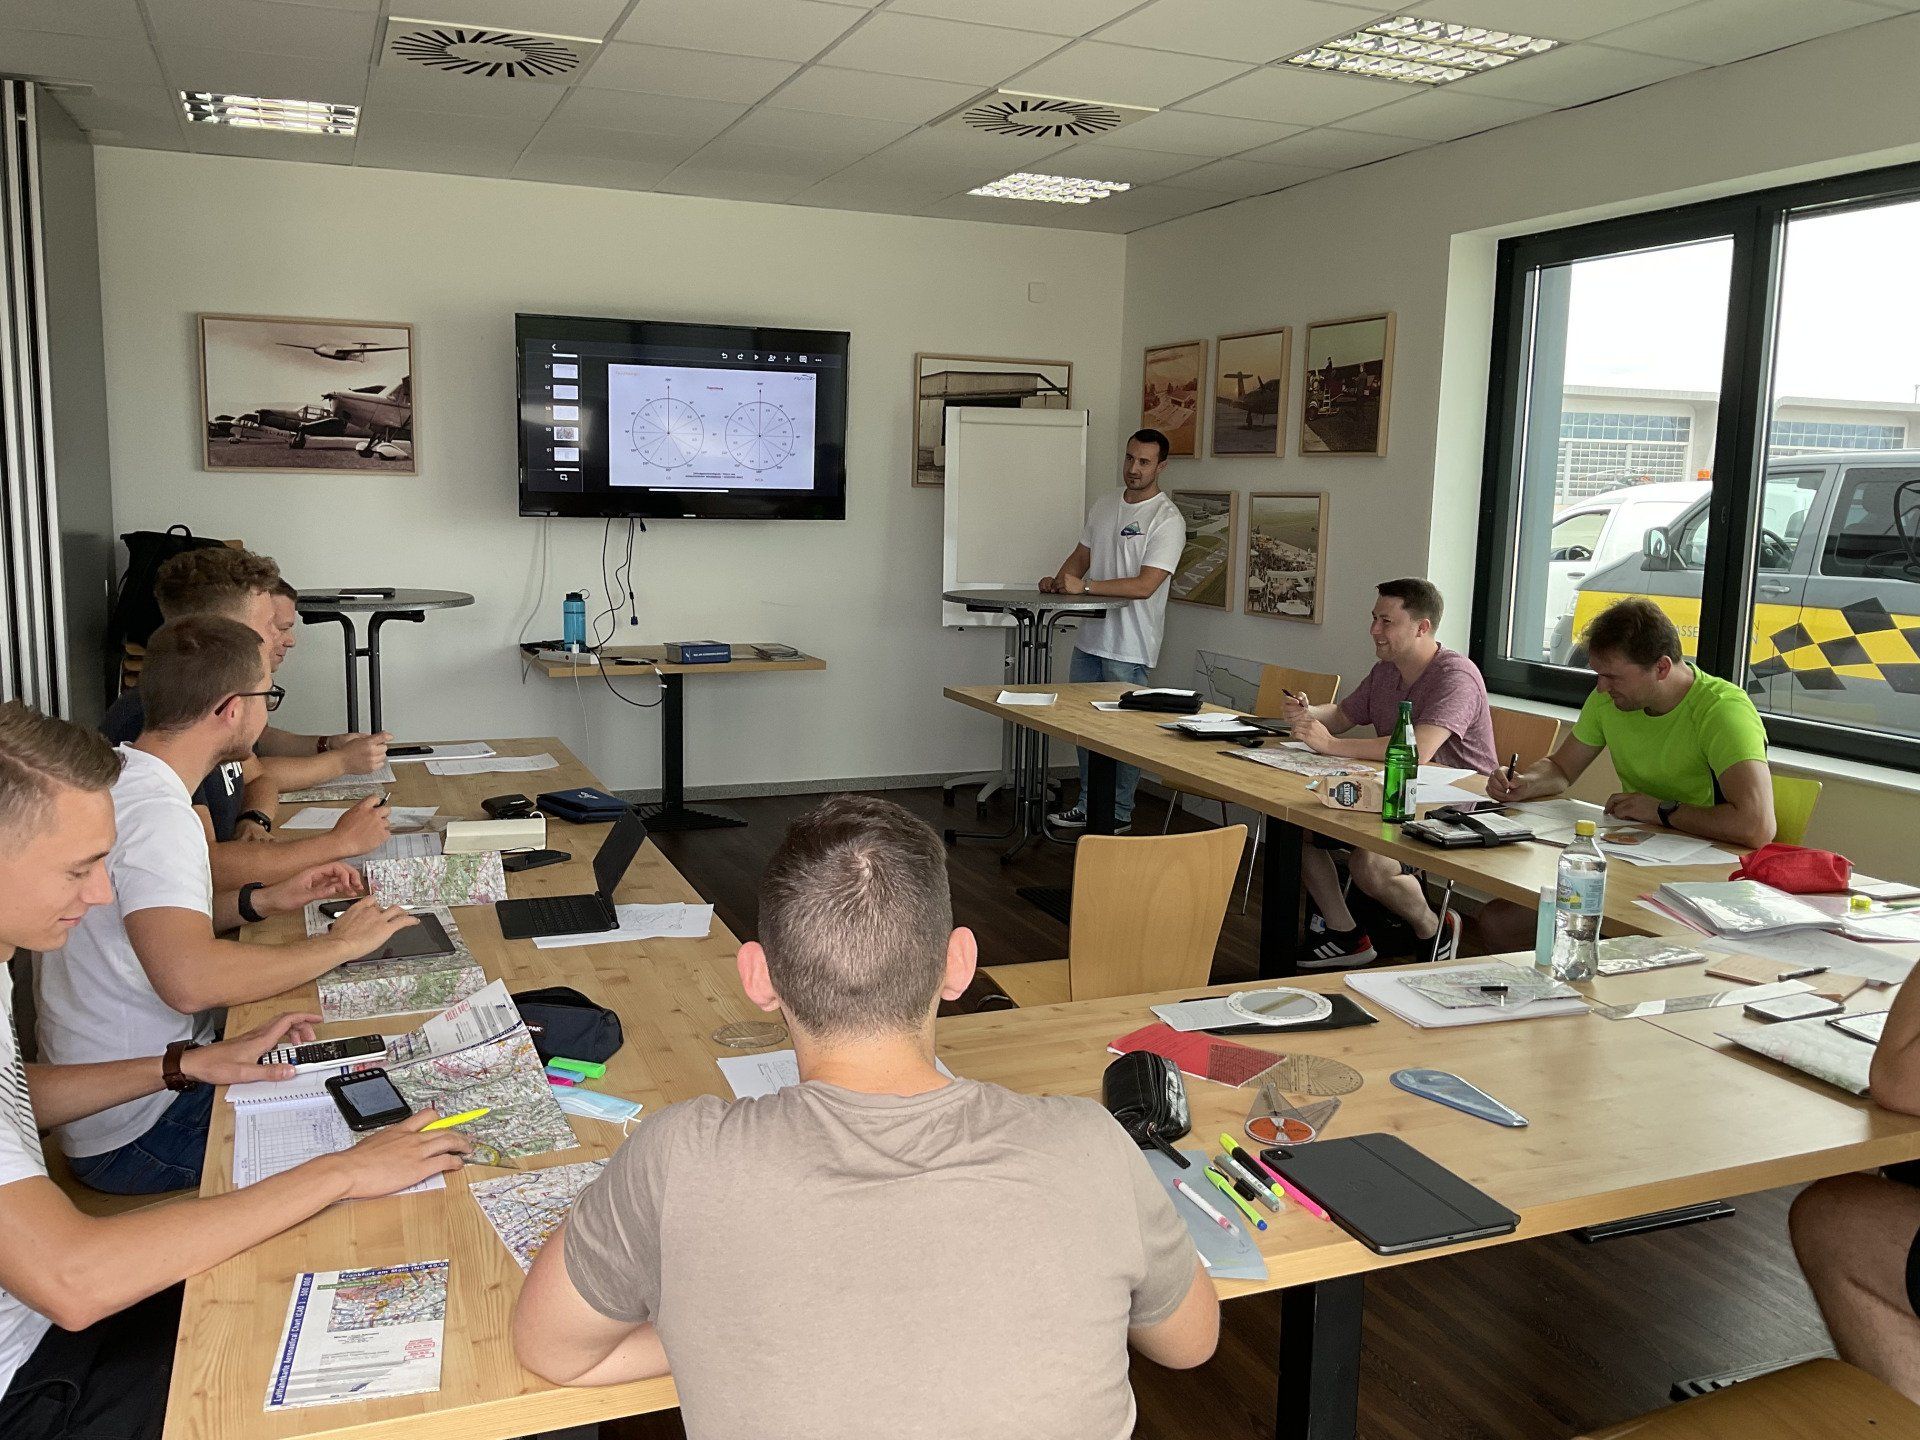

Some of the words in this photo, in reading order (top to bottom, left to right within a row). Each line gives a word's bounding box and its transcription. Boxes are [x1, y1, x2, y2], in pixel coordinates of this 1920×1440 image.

[1172, 547, 1229, 595] KASSE
[1343, 783, 1351, 805] COOKIES
[341, 1270, 376, 1279] Frankfurt
